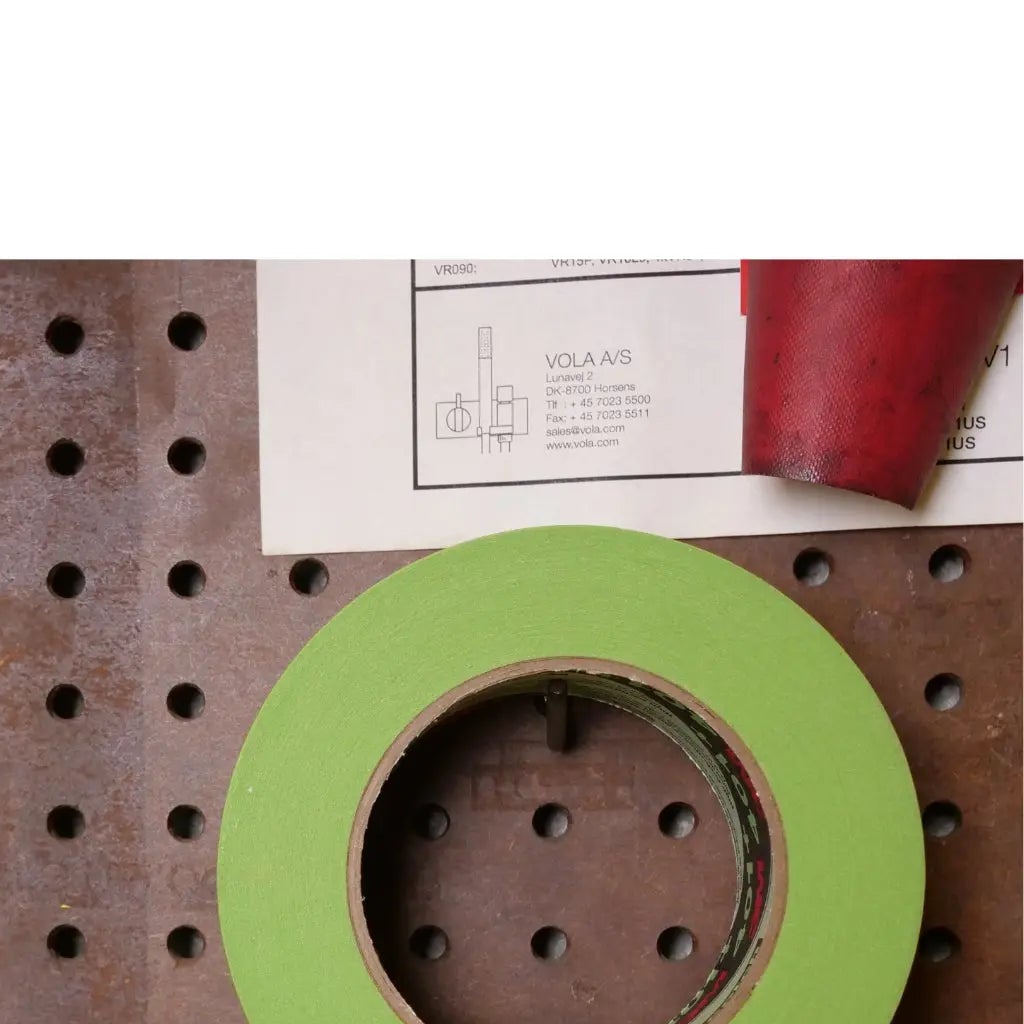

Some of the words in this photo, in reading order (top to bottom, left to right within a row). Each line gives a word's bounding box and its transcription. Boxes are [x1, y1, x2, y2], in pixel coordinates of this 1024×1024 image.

[433, 262, 478, 276] VR090:
[544, 351, 597, 370] VOLA
[599, 348, 633, 367] A/S
[545, 372, 585, 383] Lunavej
[586, 370, 594, 381] 2
[545, 384, 592, 397] DK-8700
[594, 383, 637, 394] Horsens
[579, 397, 594, 408] 45
[596, 396, 622, 407] 7023
[625, 394, 652, 405] 5500
[579, 411, 594, 421] 45
[596, 409, 622, 420] 7023
[625, 408, 650, 419] 5511
[545, 423, 626, 437] sales@vola.com
[545, 438, 620, 451] www.vola.com
